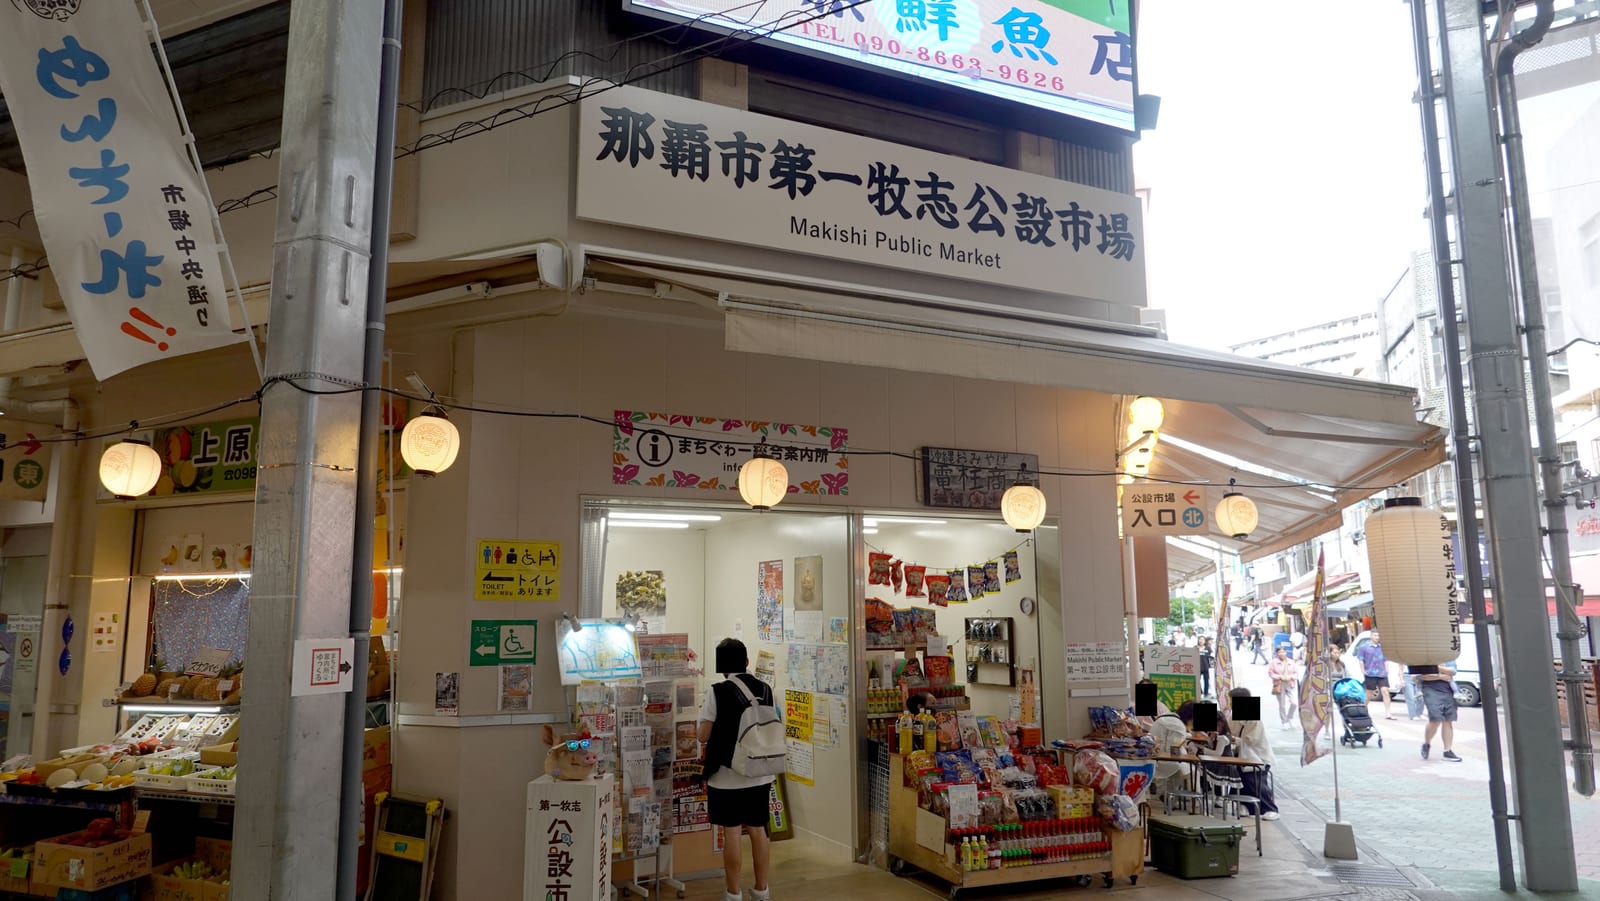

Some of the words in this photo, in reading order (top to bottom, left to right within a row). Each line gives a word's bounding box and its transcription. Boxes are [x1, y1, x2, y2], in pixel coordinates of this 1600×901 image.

[797, 19, 845, 42] TEL
[853, 31, 1066, 92] 090-8663-9626
[596, 106, 1136, 262] 那覇市第一牧志公設市場
[790, 215, 867, 247] Makishi
[875, 232, 932, 258] Public
[939, 244, 1001, 270] Market
[193, 425, 259, 466] 上原
[723, 462, 742, 472] info
[19, 464, 39, 485] 東
[1131, 493, 1176, 504] 公設市場
[1131, 508, 1176, 528] 入口
[1186, 510, 1201, 525] 北
[518, 574, 555, 586] トイレ
[518, 587, 553, 596] あります
[473, 625, 500, 633] スロープ
[1172, 662, 1194, 673] 食堂
[538, 800, 581, 812] 第一牧志
